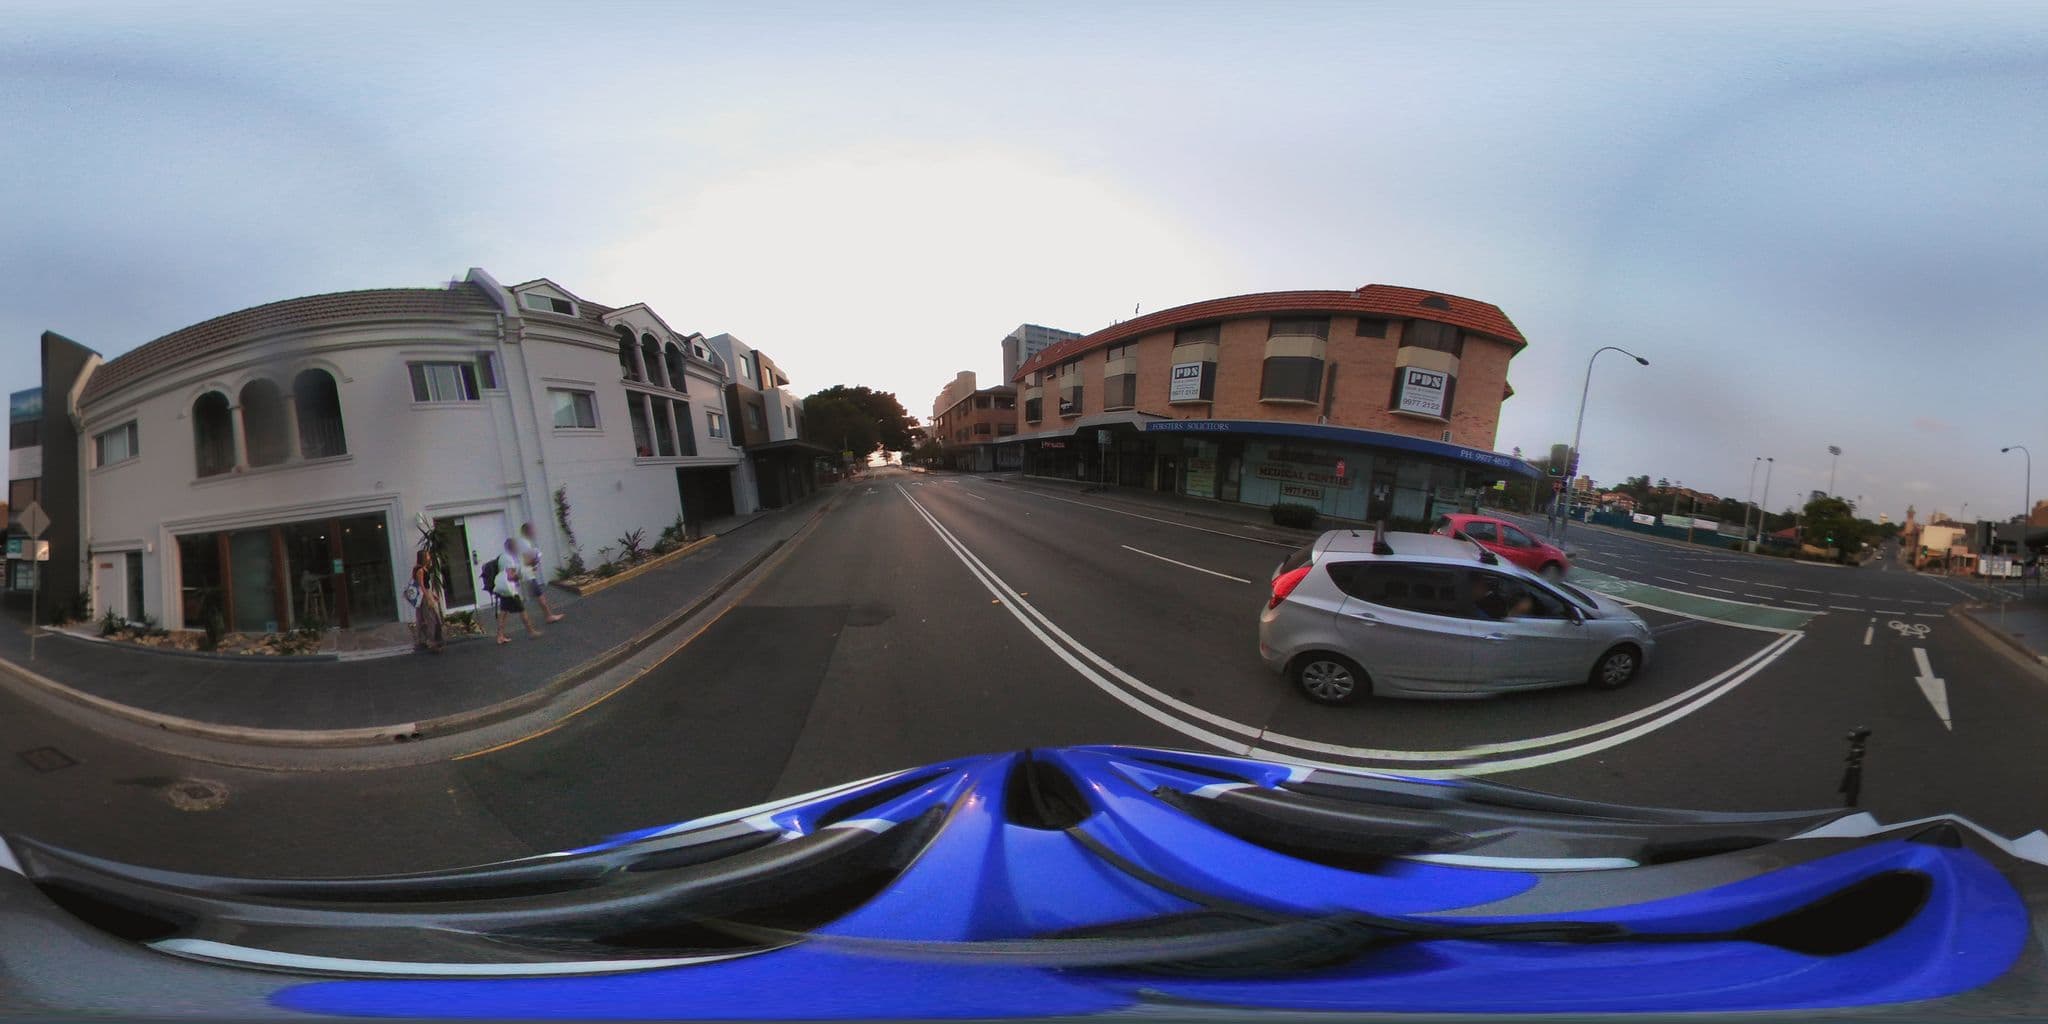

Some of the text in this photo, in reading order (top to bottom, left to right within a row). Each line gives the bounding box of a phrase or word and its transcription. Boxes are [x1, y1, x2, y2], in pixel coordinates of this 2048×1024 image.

[1176, 366, 1199, 378] PDS
[1410, 372, 1442, 389] PDS
[1403, 399, 1441, 410] 9977 2122
[1187, 422, 1230, 431] SOLICITORS
[1258, 467, 1304, 480] MEDICAL
